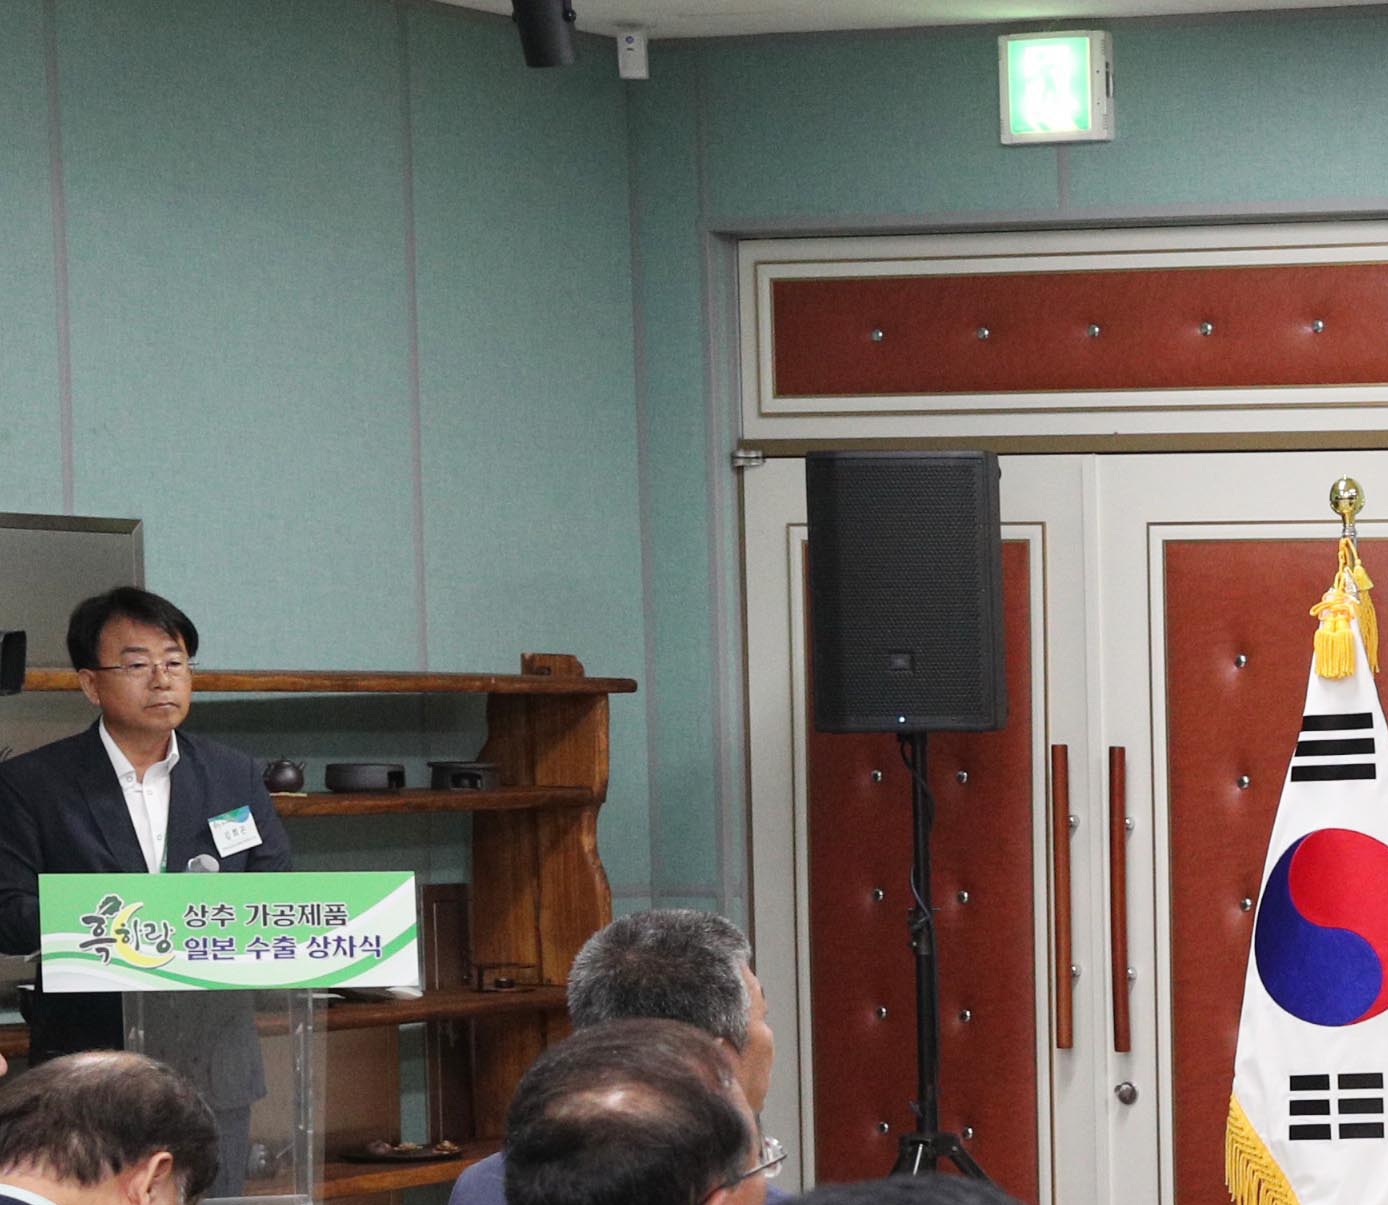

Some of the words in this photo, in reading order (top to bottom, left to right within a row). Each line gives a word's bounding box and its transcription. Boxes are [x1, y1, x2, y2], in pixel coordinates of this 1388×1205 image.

[79, 915, 174, 965] 흑하랑
[183, 904, 235, 928] 상추
[245, 903, 348, 927] 가공제품
[184, 936, 236, 961] 일본
[247, 935, 298, 960] 수출
[306, 934, 382, 959] 상차식
